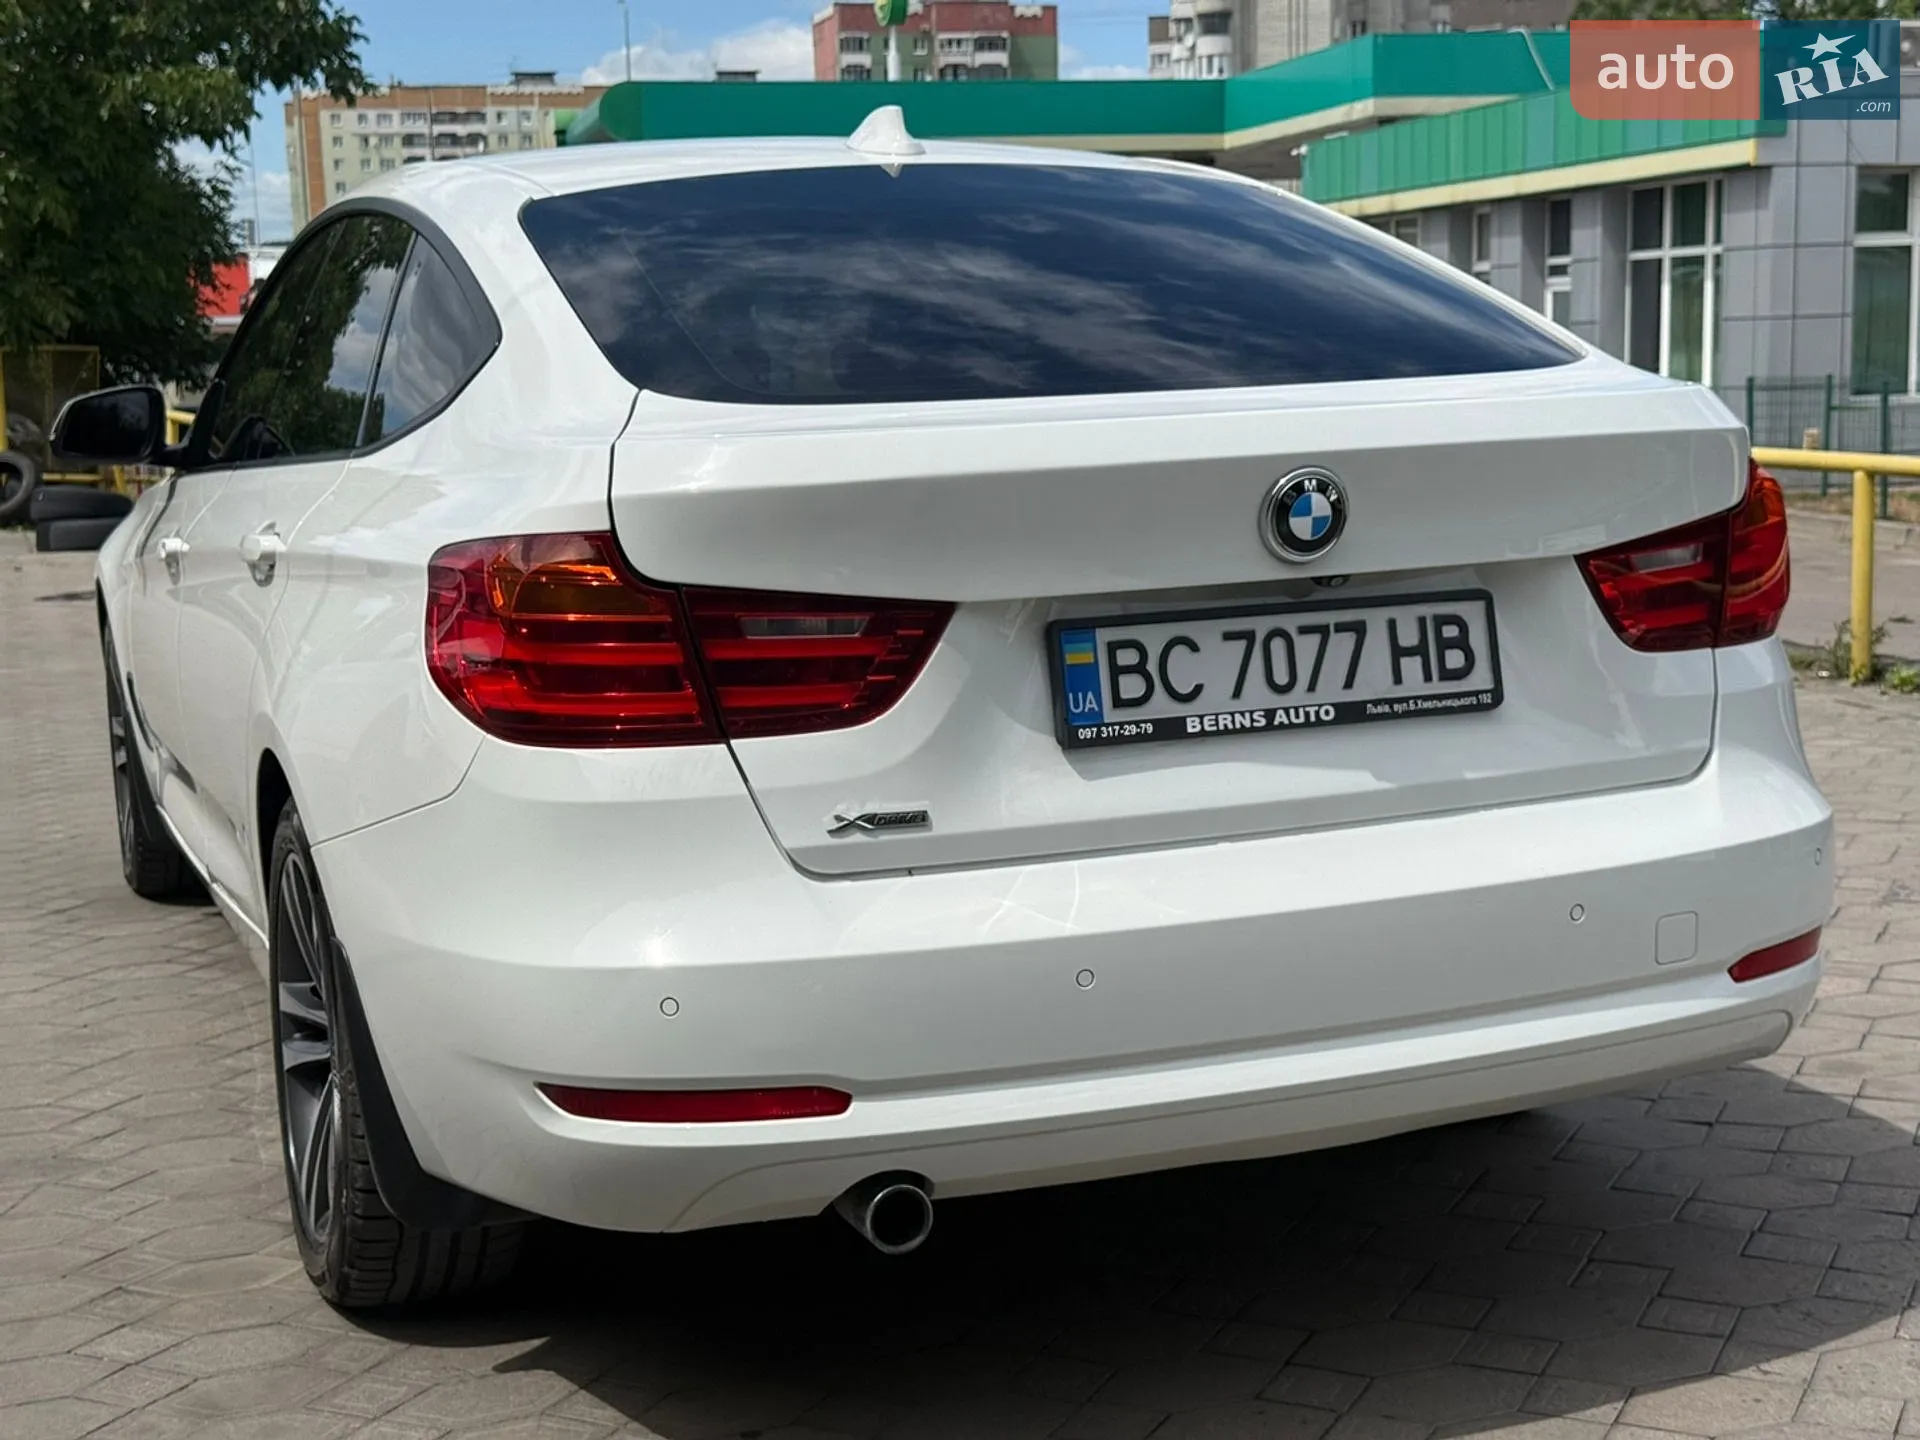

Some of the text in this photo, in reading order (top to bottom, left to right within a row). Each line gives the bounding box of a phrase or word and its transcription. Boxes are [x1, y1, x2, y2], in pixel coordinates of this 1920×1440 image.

[1106, 613, 1476, 709] BC 7077 HB
[1069, 691, 1099, 713] UA
[1078, 723, 1153, 739] 097 317-29-79
[1186, 704, 1335, 733] BERNS AUTO
